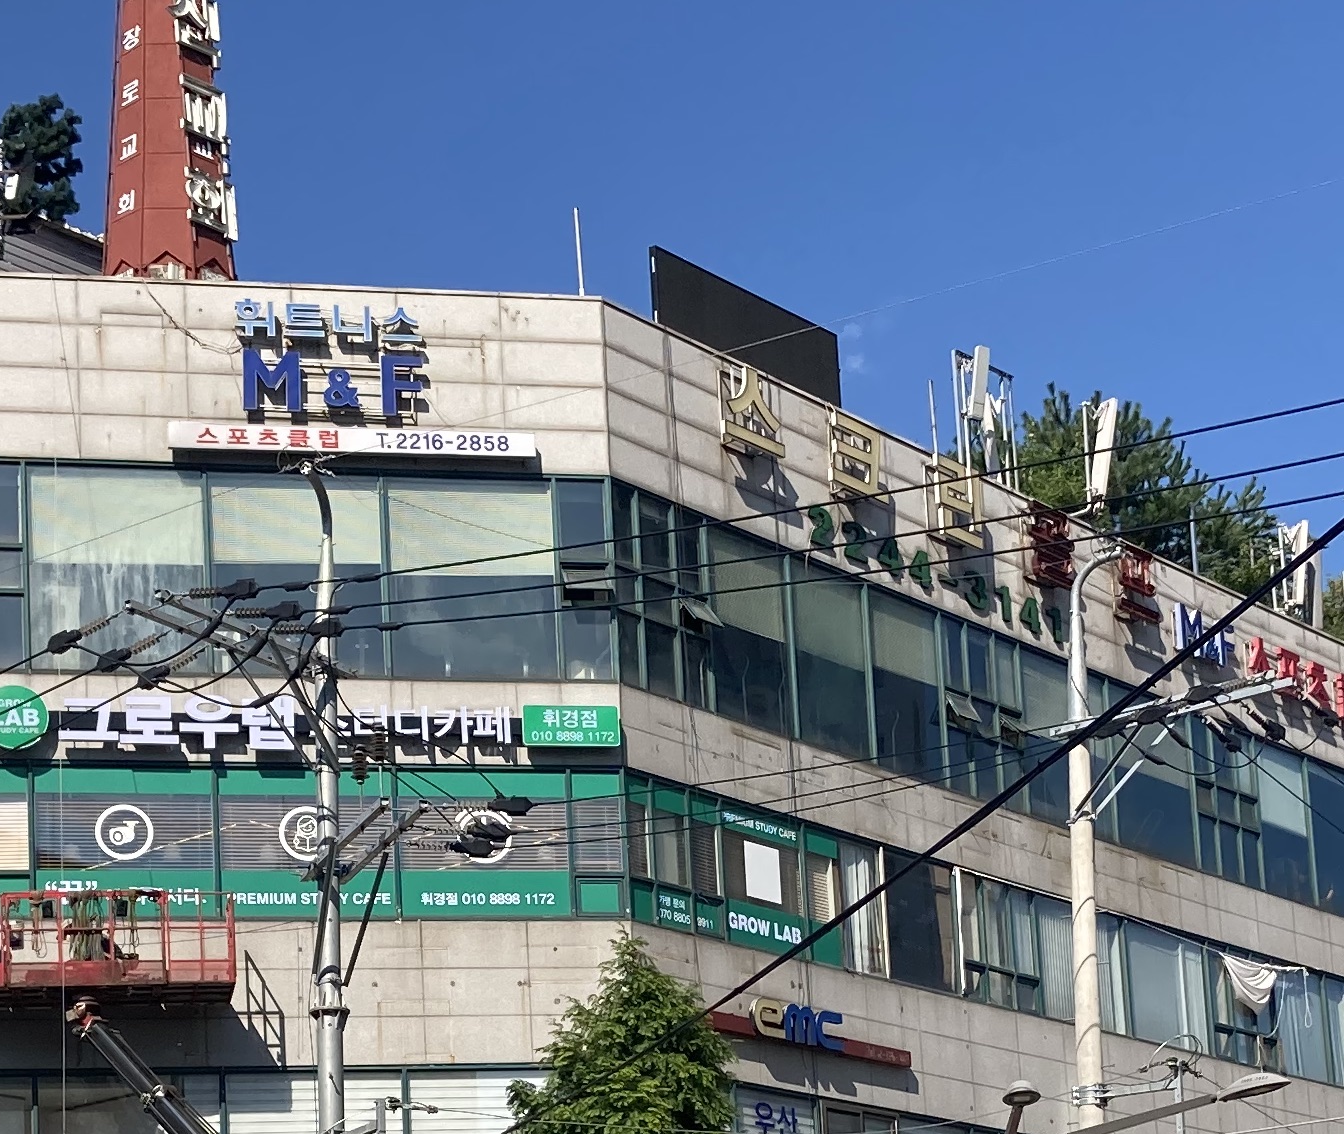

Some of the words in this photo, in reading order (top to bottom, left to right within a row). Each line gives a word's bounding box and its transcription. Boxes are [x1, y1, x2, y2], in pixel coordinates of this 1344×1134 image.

[117, 24, 142, 216] 장로교회
[234, 298, 425, 345] 휘트니스
[195, 424, 341, 451] 스포츠클럽
[376, 431, 510, 453] T.2216-2858
[807, 504, 1064, 645] 2244-3141
[57, 694, 297, 752] 그로우랩
[542, 707, 599, 729] 휘경점
[19, 727, 40, 736] CAFE
[531, 730, 553, 744] 010
[556, 730, 584, 744] 8898
[588, 729, 614, 744] 1172
[755, 820, 777, 836] STUDY
[778, 826, 797, 842] CAFE
[299, 892, 350, 905] STY
[420, 891, 458, 906] 휘경점
[462, 892, 486, 905] 010
[490, 892, 520, 905] 8898
[524, 892, 554, 905] 1172
[728, 911, 770, 937] GROW
[774, 922, 802, 945] LAB
